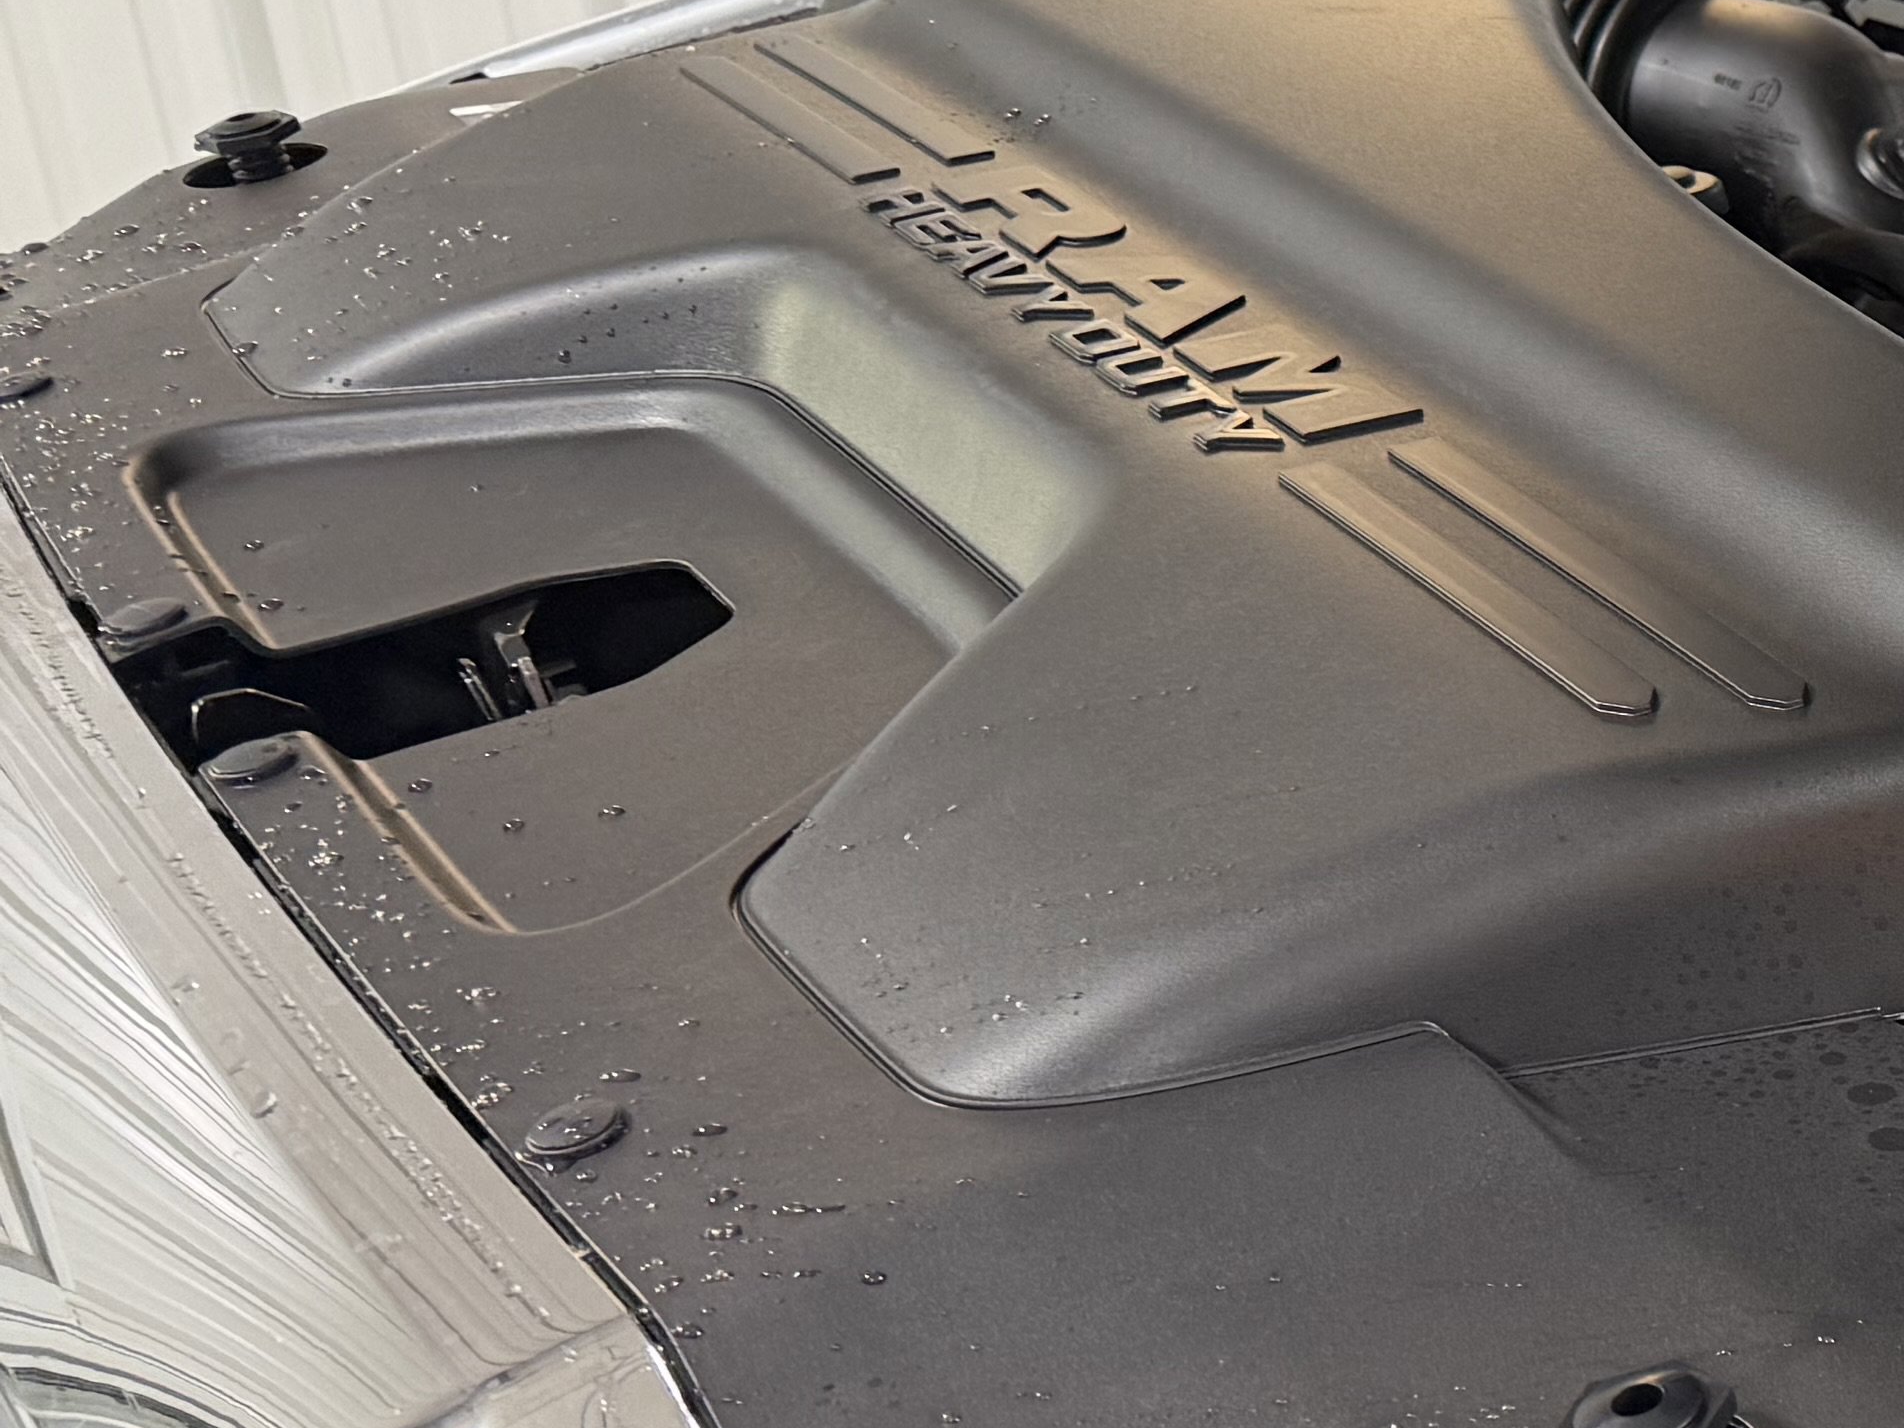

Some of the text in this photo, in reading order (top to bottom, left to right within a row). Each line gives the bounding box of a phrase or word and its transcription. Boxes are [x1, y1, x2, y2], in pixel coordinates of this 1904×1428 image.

[857, 186, 1286, 454] HEAVY DUTY
[932, 163, 1426, 445] RAM
